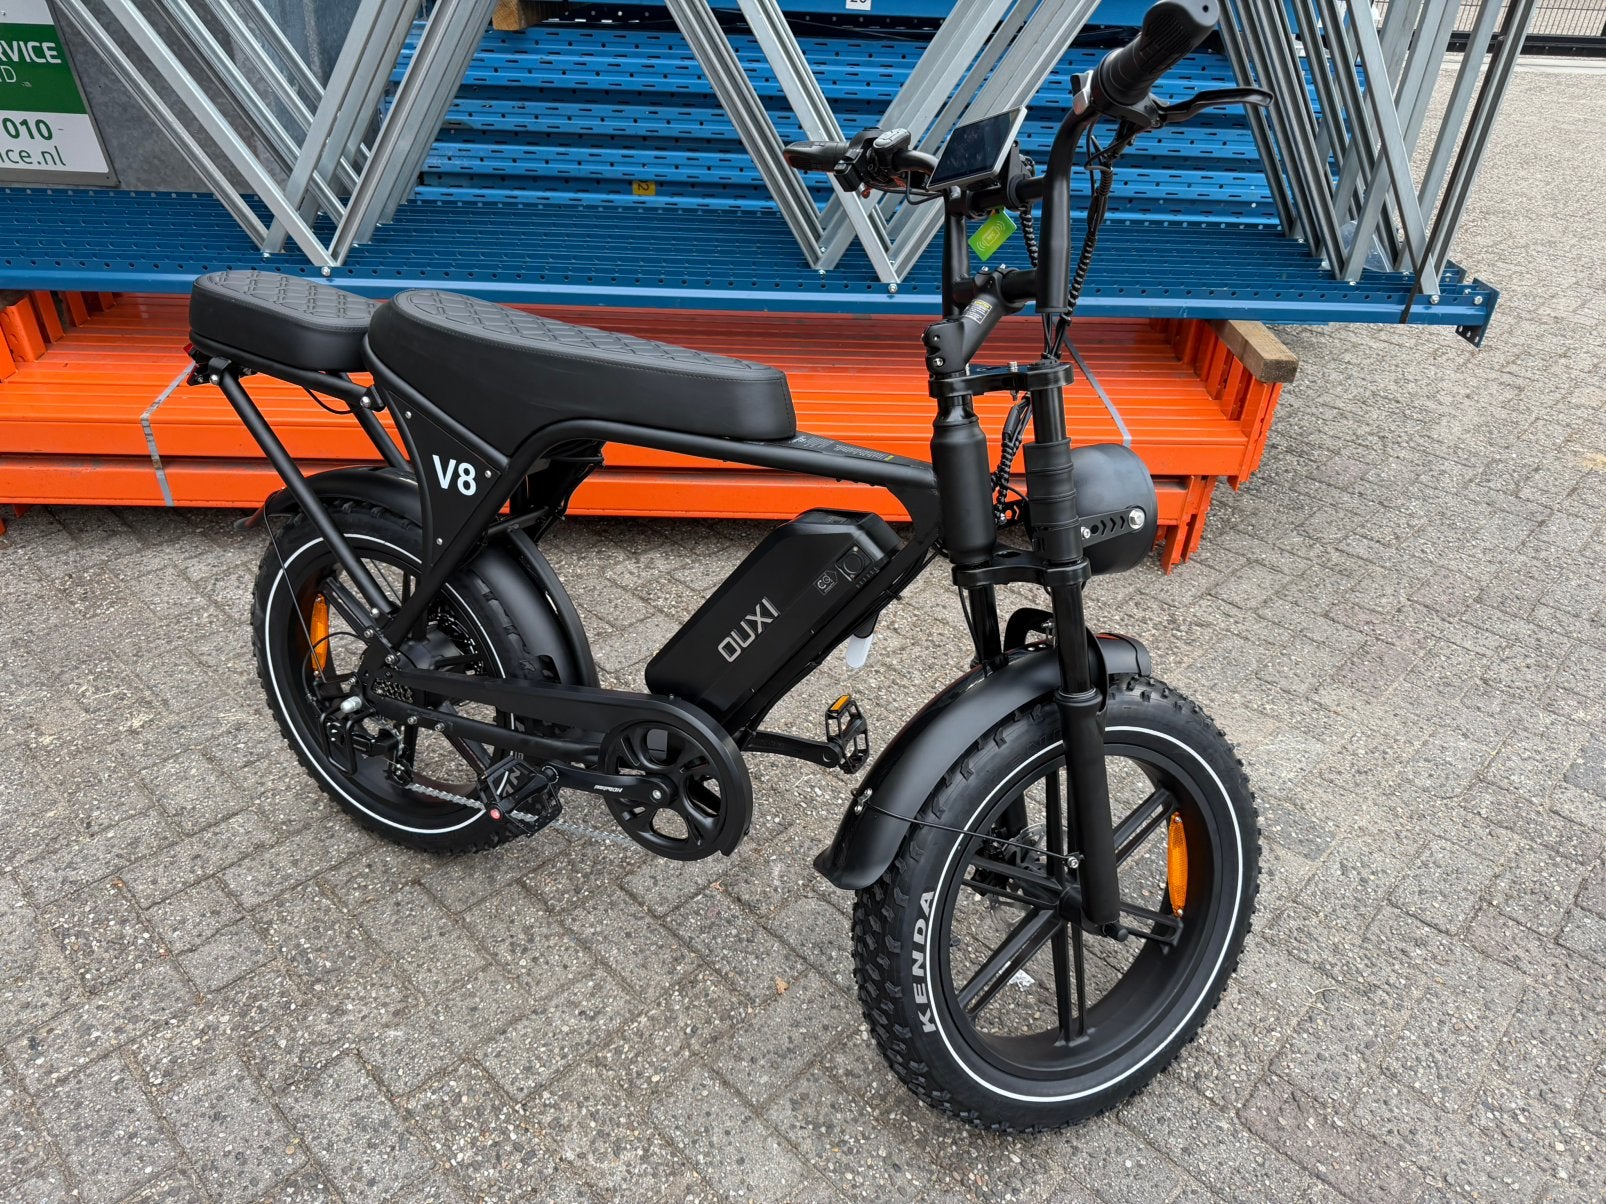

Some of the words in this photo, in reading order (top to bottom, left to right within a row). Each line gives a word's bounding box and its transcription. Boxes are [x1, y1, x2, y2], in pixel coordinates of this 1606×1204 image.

[2, 117, 54, 141] 010
[432, 454, 477, 496] V8
[717, 598, 780, 663] OUXI
[911, 891, 937, 1033] KENDA
